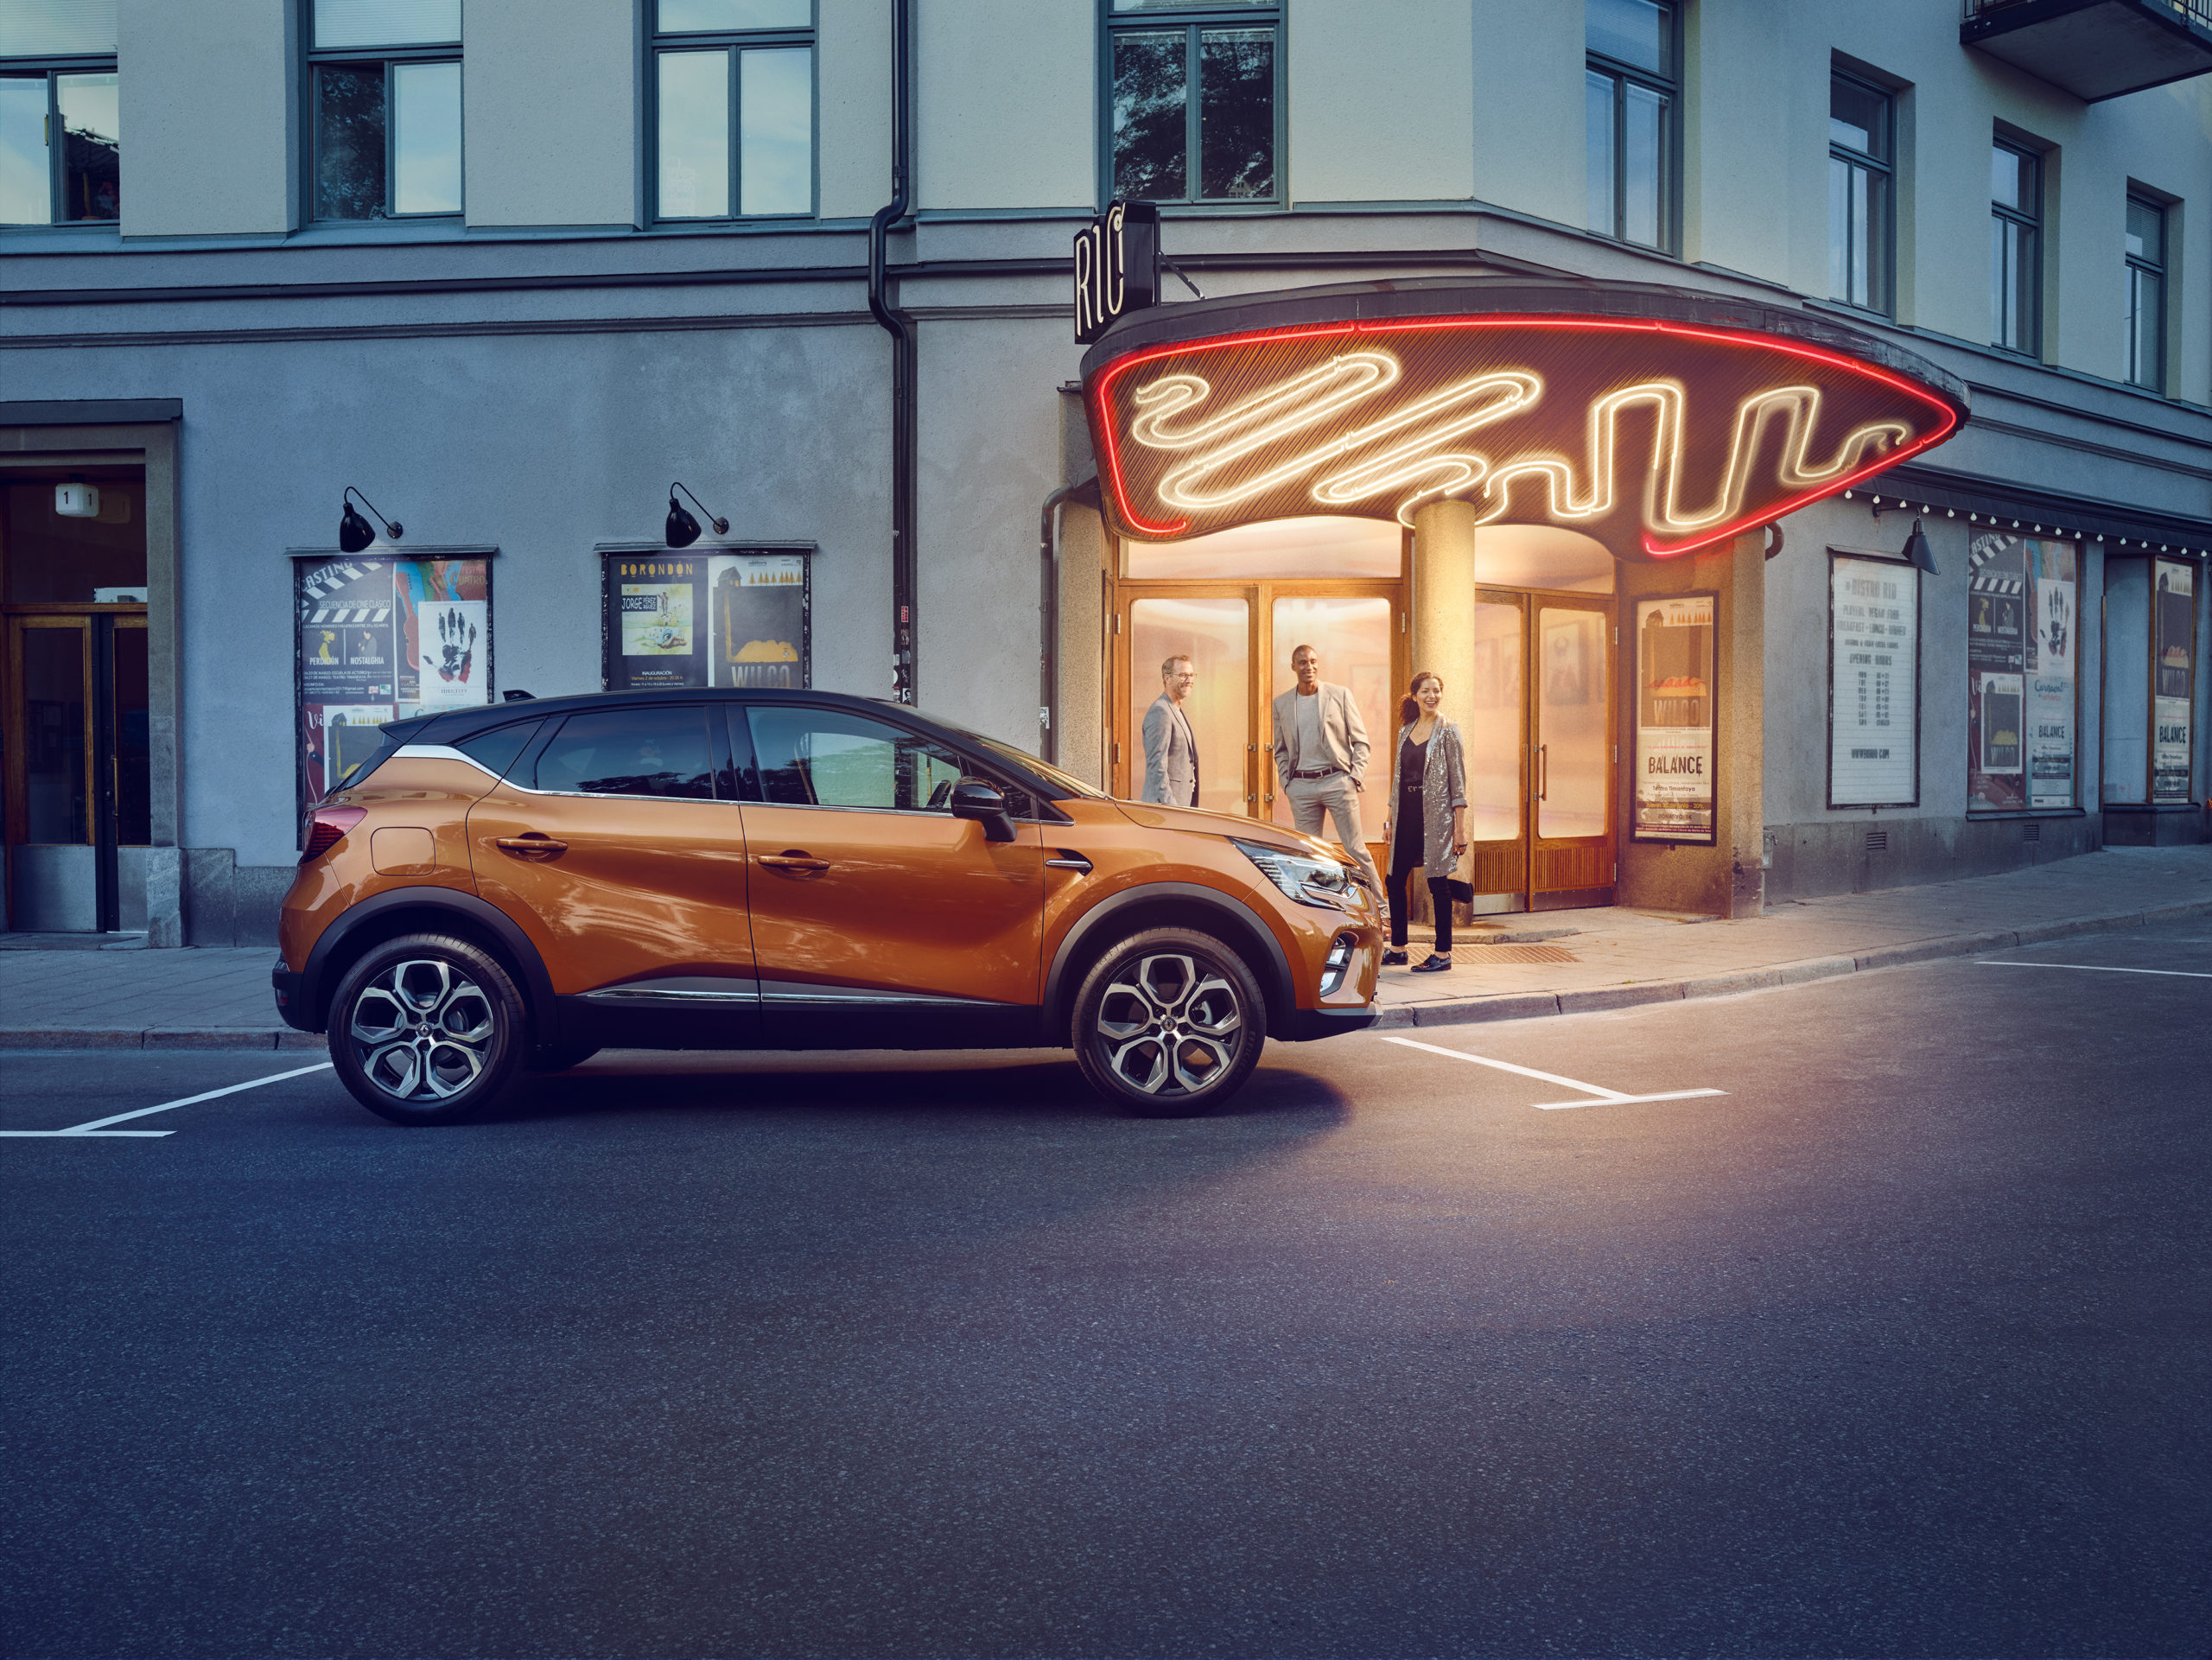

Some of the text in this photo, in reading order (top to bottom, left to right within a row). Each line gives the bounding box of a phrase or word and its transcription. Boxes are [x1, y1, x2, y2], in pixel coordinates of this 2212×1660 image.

[63, 491, 69, 505] 1
[88, 493, 92, 507] 1
[302, 562, 353, 592] ASTIN
[622, 598, 642, 609] JORGE
[350, 657, 385, 665] NOSTALGHIA
[2038, 725, 2065, 739] BALANCE
[2159, 726, 2186, 743] BALANCE
[1649, 754, 1703, 777] BALANCE
